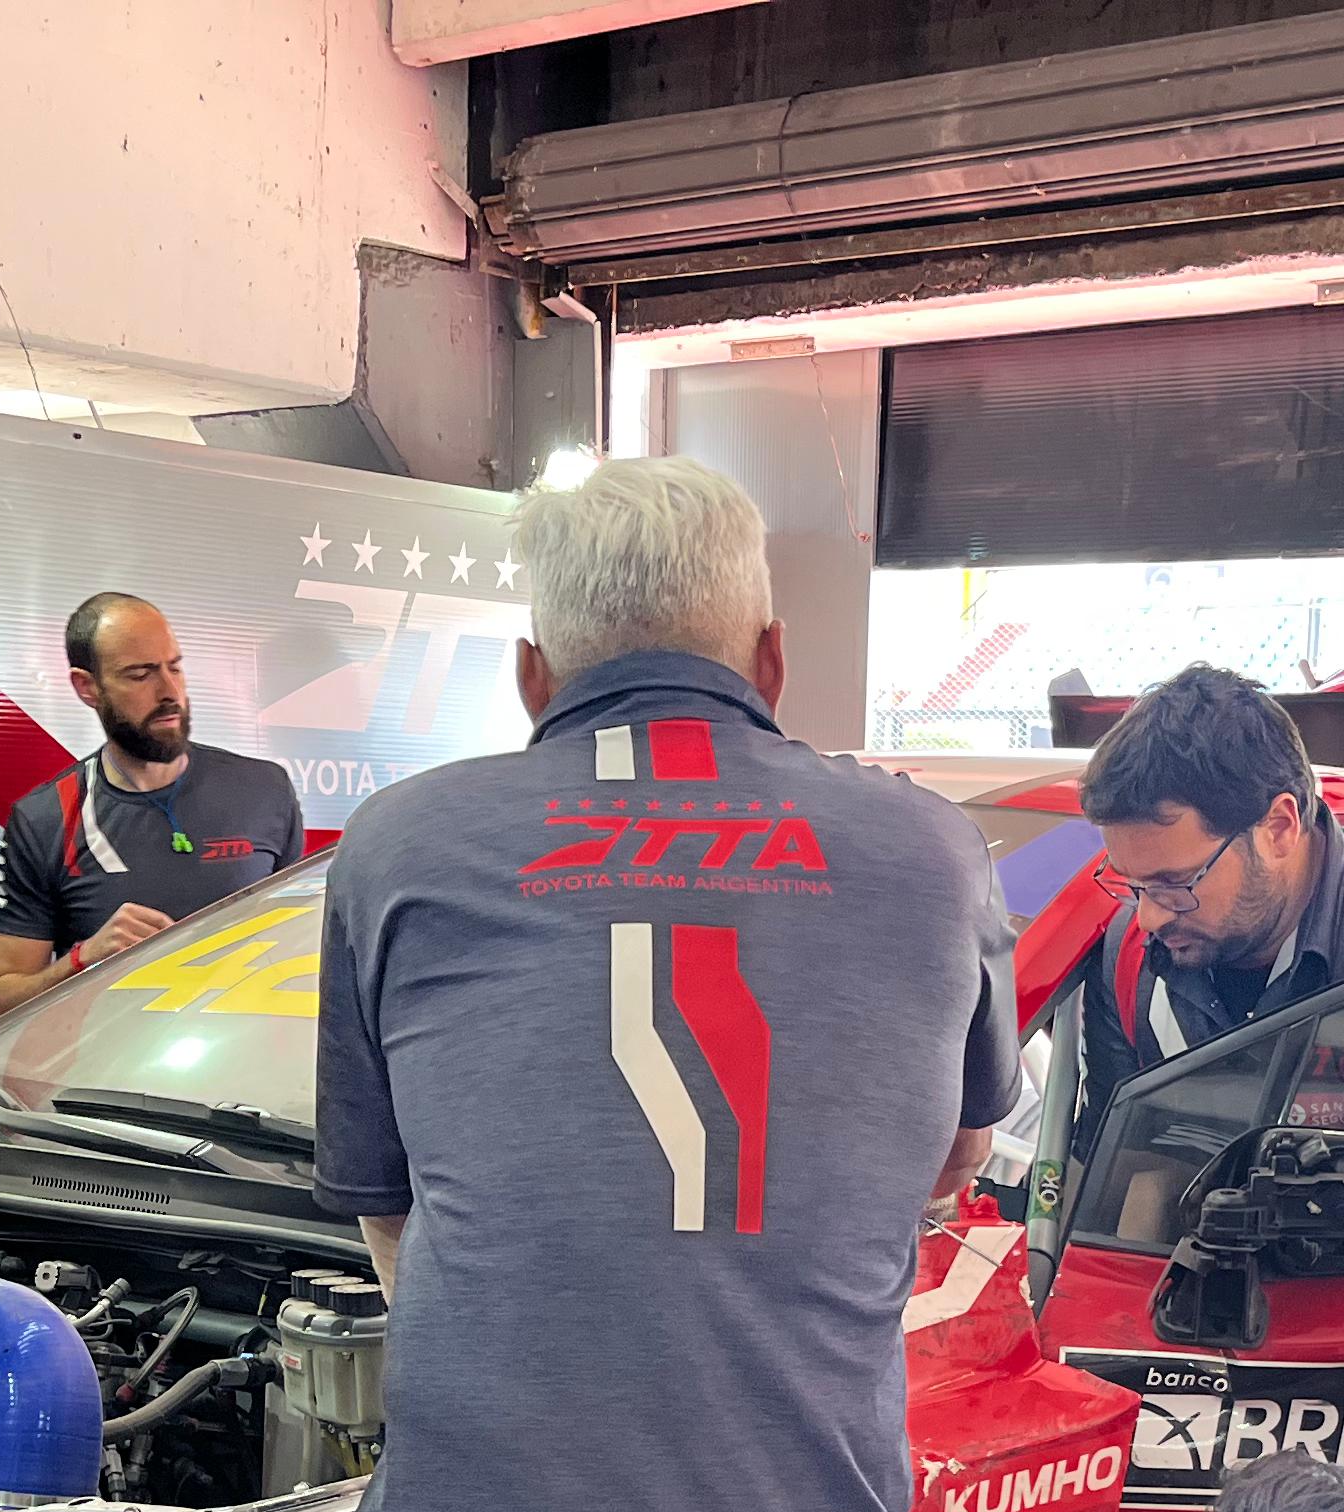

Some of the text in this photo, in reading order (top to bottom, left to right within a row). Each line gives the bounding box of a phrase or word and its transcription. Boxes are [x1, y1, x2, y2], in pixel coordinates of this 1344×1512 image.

[518, 872, 833, 898] TOYOTA TEAM ARGENTINA
[1146, 1367, 1229, 1392] banco
